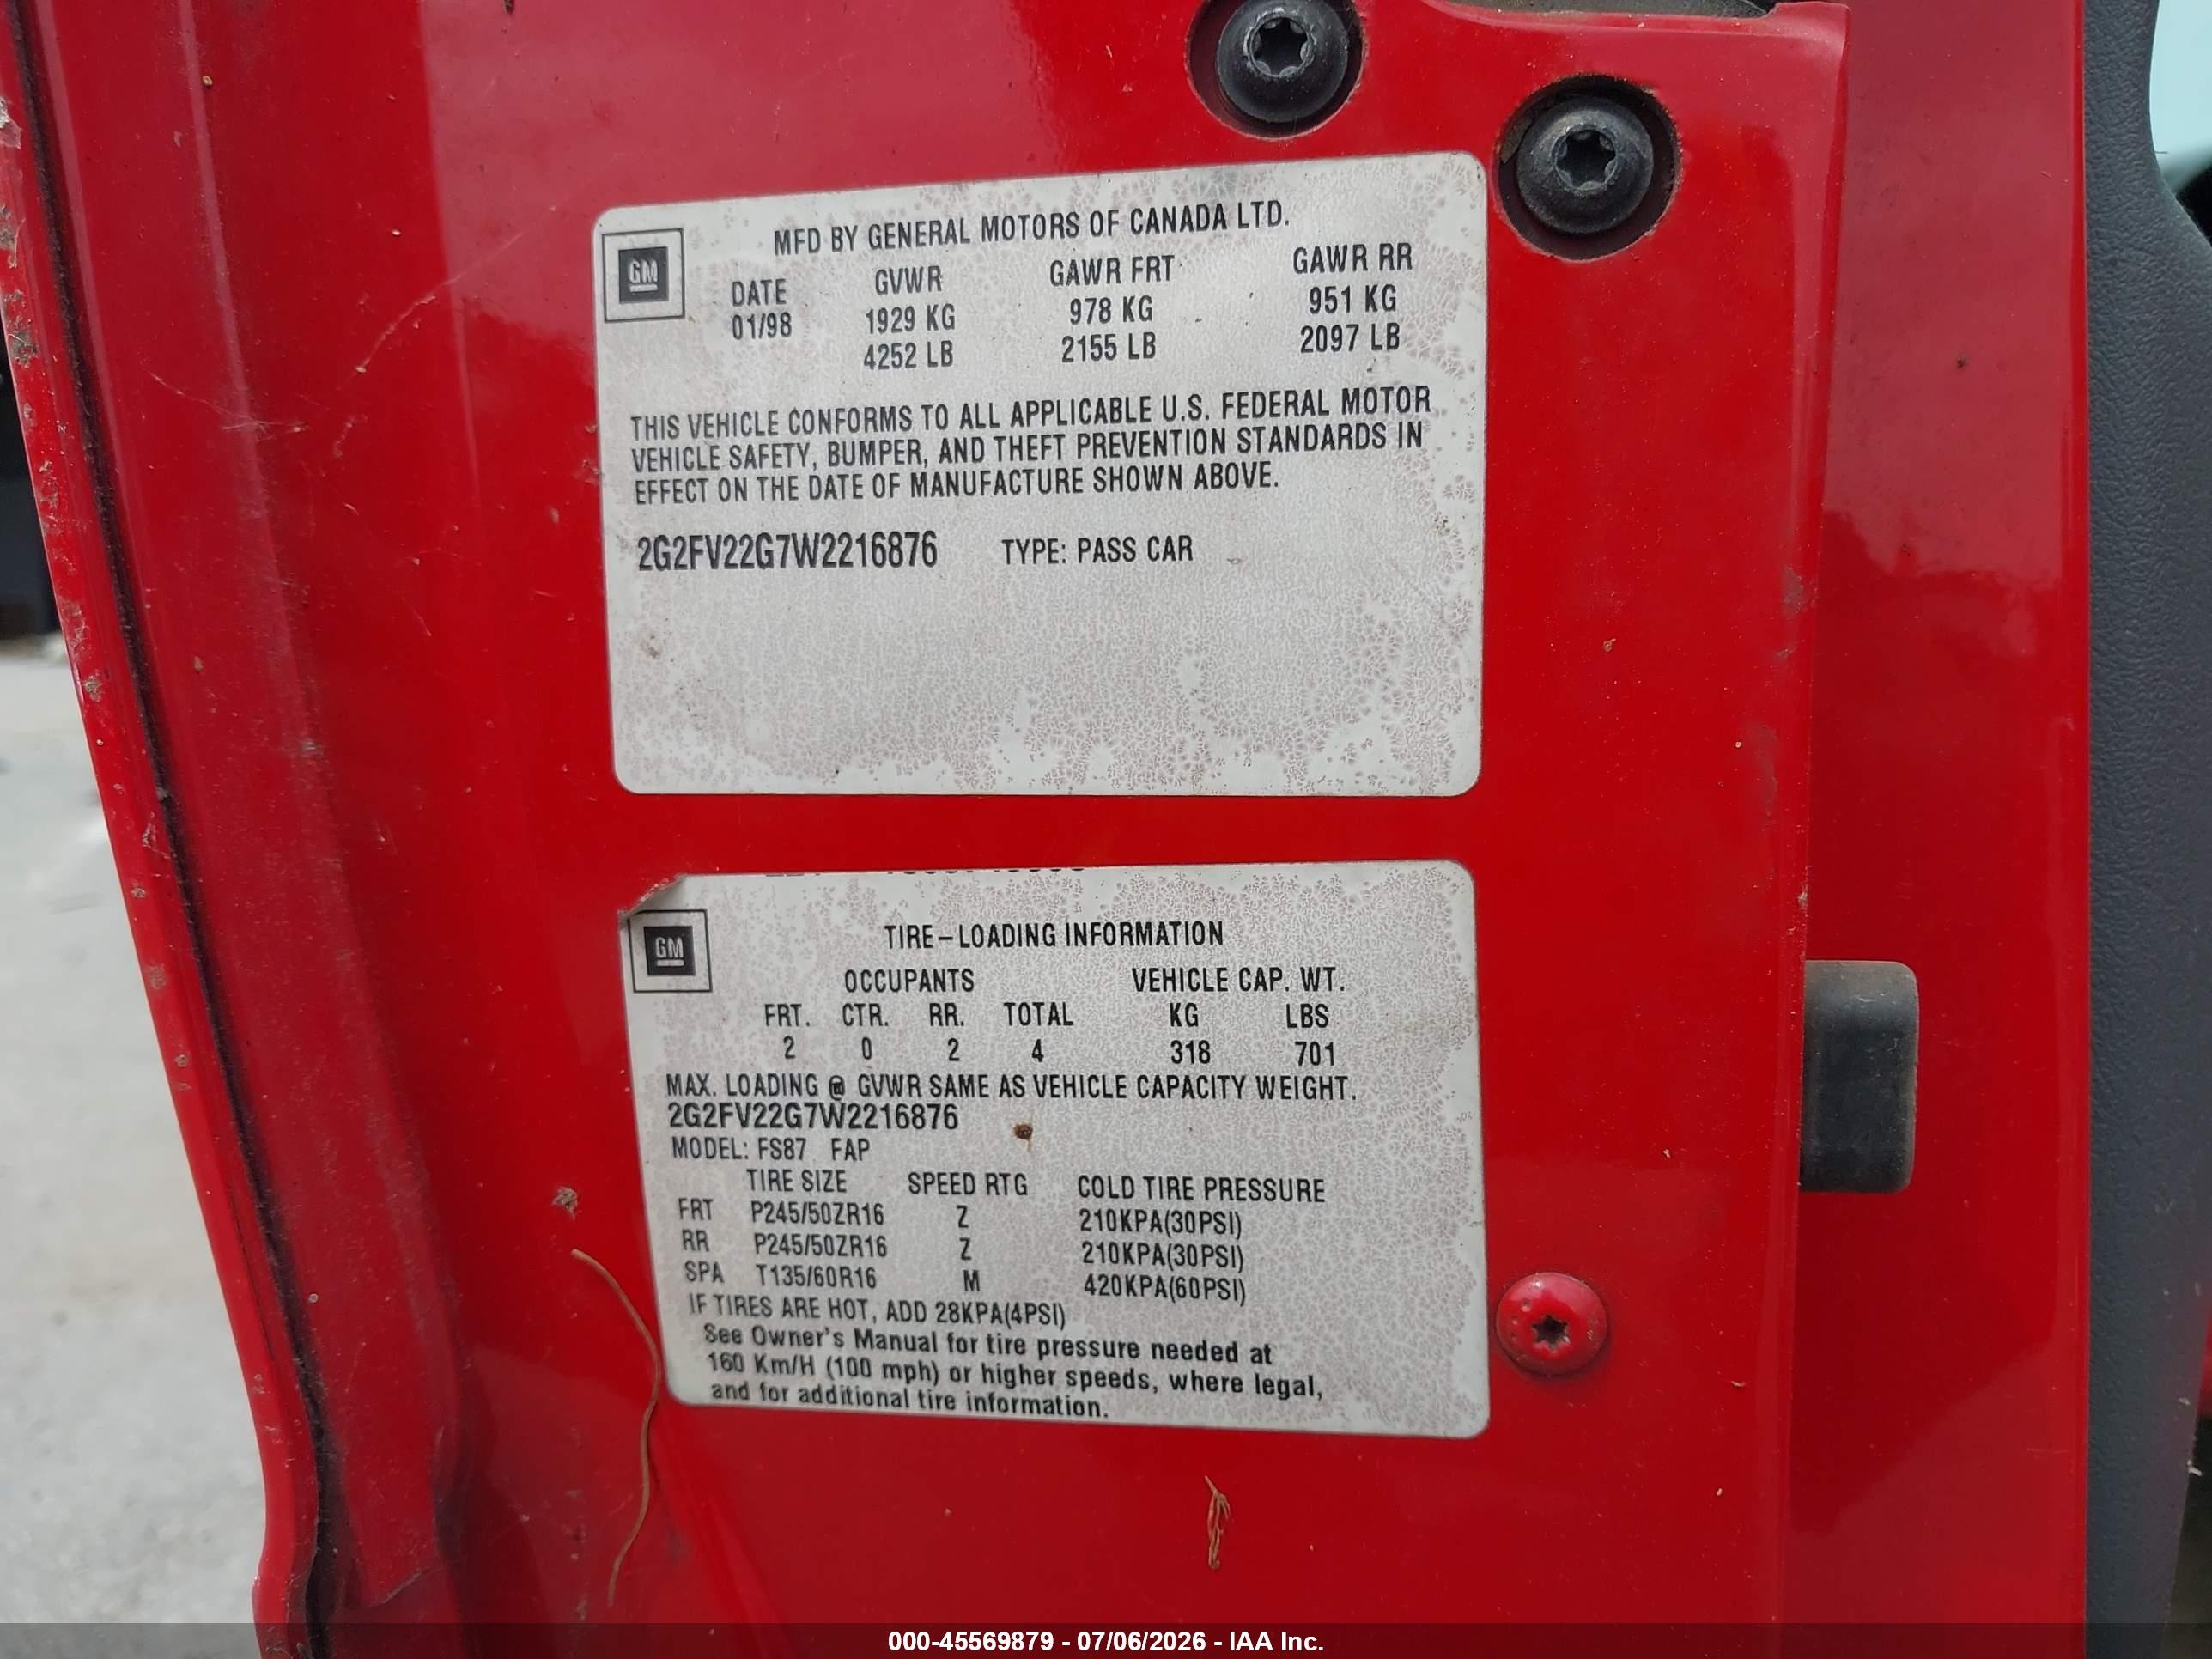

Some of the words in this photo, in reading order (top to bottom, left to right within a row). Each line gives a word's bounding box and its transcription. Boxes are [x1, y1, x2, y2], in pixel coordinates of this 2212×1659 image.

[775, 229, 820, 256] MFD
[831, 226, 858, 252] BY
[868, 219, 970, 250] GENERAL
[981, 212, 1079, 242] MOTORS
[1090, 210, 1119, 236] OF
[1130, 204, 1227, 234] CANADA
[1238, 199, 1290, 229] LTD.
[628, 260, 659, 283] GM
[1049, 258, 1121, 287] GAWR
[1132, 255, 1175, 283] FRT
[1293, 246, 1367, 274] GAWR
[1379, 243, 1413, 270] RR
[732, 279, 787, 307] DATE
[875, 266, 942, 295] GVWR
[1070, 298, 1112, 325] 978
[1122, 295, 1153, 322] KG
[1309, 286, 1351, 314] 951
[1364, 284, 1396, 312] KG
[732, 312, 792, 340] 01/98
[866, 306, 915, 335] 1929
[927, 304, 956, 331] KG
[1061, 334, 1117, 363] 2155
[1128, 332, 1156, 360] LB
[1300, 325, 1358, 354] 2097
[1370, 323, 1401, 350] LB
[864, 343, 917, 370] 4252
[927, 340, 954, 367] LB
[631, 414, 679, 441] THIS
[688, 410, 779, 439] VEHICLE
[788, 404, 912, 434] CONFORMS
[921, 404, 948, 430] TO
[959, 402, 1000, 429] ALL
[1011, 396, 1152, 428] APPLICABLE
[1162, 393, 1210, 421] U.S.
[1222, 389, 1329, 419] FEDERAL
[1340, 386, 1431, 416] MOTOR
[632, 445, 720, 473] VEHICLE
[729, 441, 817, 471] SAFETY,
[828, 439, 928, 467] BUMPER,
[939, 437, 984, 464] AND
[994, 434, 1066, 462] THEFT
[1077, 428, 1226, 459] PREVENTION
[1237, 422, 1387, 453] STANDARDS
[1398, 422, 1422, 448] IN
[635, 477, 708, 505] EFFECT
[718, 477, 747, 502] ON
[757, 475, 799, 501] THE
[809, 473, 863, 500] DATE
[872, 472, 900, 498] OF
[910, 467, 1083, 498] MANUFACTURE
[1093, 465, 1182, 492] SHOWN
[1194, 460, 1279, 489] ABOVE.
[638, 530, 938, 571] 2G2FV22G7W2216876
[1001, 538, 1066, 565] TYPE:
[1078, 536, 1136, 562] PASS
[1147, 535, 1194, 562] CAR
[1066, 921, 1224, 947] INFORMATION
[654, 936, 685, 960] GM
[844, 969, 975, 993] OCCUPANTS
[1132, 967, 1228, 993] VEHICLE
[1239, 967, 1290, 993] CAP.
[1301, 966, 1345, 992] WT.
[765, 1004, 810, 1027] FRT.
[842, 1003, 888, 1027] CTR.
[930, 1002, 964, 1027] RR.
[1004, 1001, 1074, 1027] TOTAL
[1170, 1002, 1199, 1028] KG
[1285, 1004, 1329, 1029] LBS
[784, 1036, 796, 1060] 2
[861, 1037, 872, 1060] 0
[947, 1039, 960, 1062] 2
[1031, 1038, 1044, 1063] 4
[1170, 1039, 1211, 1065] 318
[1295, 1042, 1335, 1066] 701
[667, 1073, 716, 1097] MAX.
[726, 1073, 817, 1097] LOADING
[829, 1076, 845, 1100] @
[858, 1073, 921, 1098] GVWR
[930, 1073, 989, 1098] SAME
[999, 1073, 1026, 1098] AS
[1034, 1073, 1127, 1099] VEHICLE
[1137, 1074, 1245, 1100] CAPACITY
[1256, 1075, 1356, 1101] WEIGHT.
[669, 1103, 958, 1130] 2G2FV22G7W2216876
[672, 1137, 749, 1160] MODEL:
[758, 1138, 806, 1160] FS87
[831, 1138, 871, 1161] FAP
[747, 1169, 793, 1192] TIRE
[802, 1170, 848, 1194] SIZE
[908, 1172, 975, 1195] SPEED
[986, 1173, 1027, 1195] RTG
[1079, 1175, 1134, 1199] COLD
[1143, 1176, 1194, 1200] TIRE
[1204, 1177, 1326, 1202] PRESSURE
[678, 1198, 714, 1221] FRT
[751, 1200, 884, 1225] P245/50ZR16
[957, 1206, 969, 1229] Z
[1079, 1209, 1242, 1239] 210KPA(30PSI)
[683, 1230, 709, 1252] RR
[755, 1233, 887, 1258] P245/50ZR16
[960, 1237, 971, 1260] Z
[1082, 1241, 1243, 1272] 210KPA(30PSI)
[685, 1261, 724, 1284] SPA
[756, 1264, 877, 1288] T135/60R16
[963, 1270, 980, 1292] M
[1084, 1273, 1246, 1306] 420KPA(60PSI)
[690, 1293, 707, 1315] IF
[713, 1295, 773, 1317] TIRES
[782, 1296, 819, 1319] ARE
[830, 1297, 877, 1323] HOT,
[886, 1299, 927, 1322] ADD
[935, 1301, 1065, 1330] 28KPA(4PSI)
[704, 1323, 742, 1345] See
[854, 1329, 938, 1353] Manual
[947, 1331, 978, 1354] for
[987, 1333, 1026, 1355] tire
[1038, 1340, 1140, 1360] pressure
[1152, 1340, 1238, 1363] needed
[1249, 1345, 1273, 1364] at
[708, 1352, 744, 1373] 160
[755, 1353, 816, 1377] Km/H
[826, 1358, 872, 1380] (100
[882, 1359, 940, 1387] mph)
[949, 1366, 969, 1382] or
[981, 1364, 1055, 1388] higher
[1066, 1369, 1158, 1393] speeds,
[1170, 1371, 1243, 1394] where
[1255, 1373, 1322, 1400] legal,
[712, 1382, 750, 1401] and
[760, 1383, 790, 1402] for
[799, 1385, 909, 1409] additional
[918, 1388, 956, 1410] tire
[966, 1390, 1109, 1417] information.
